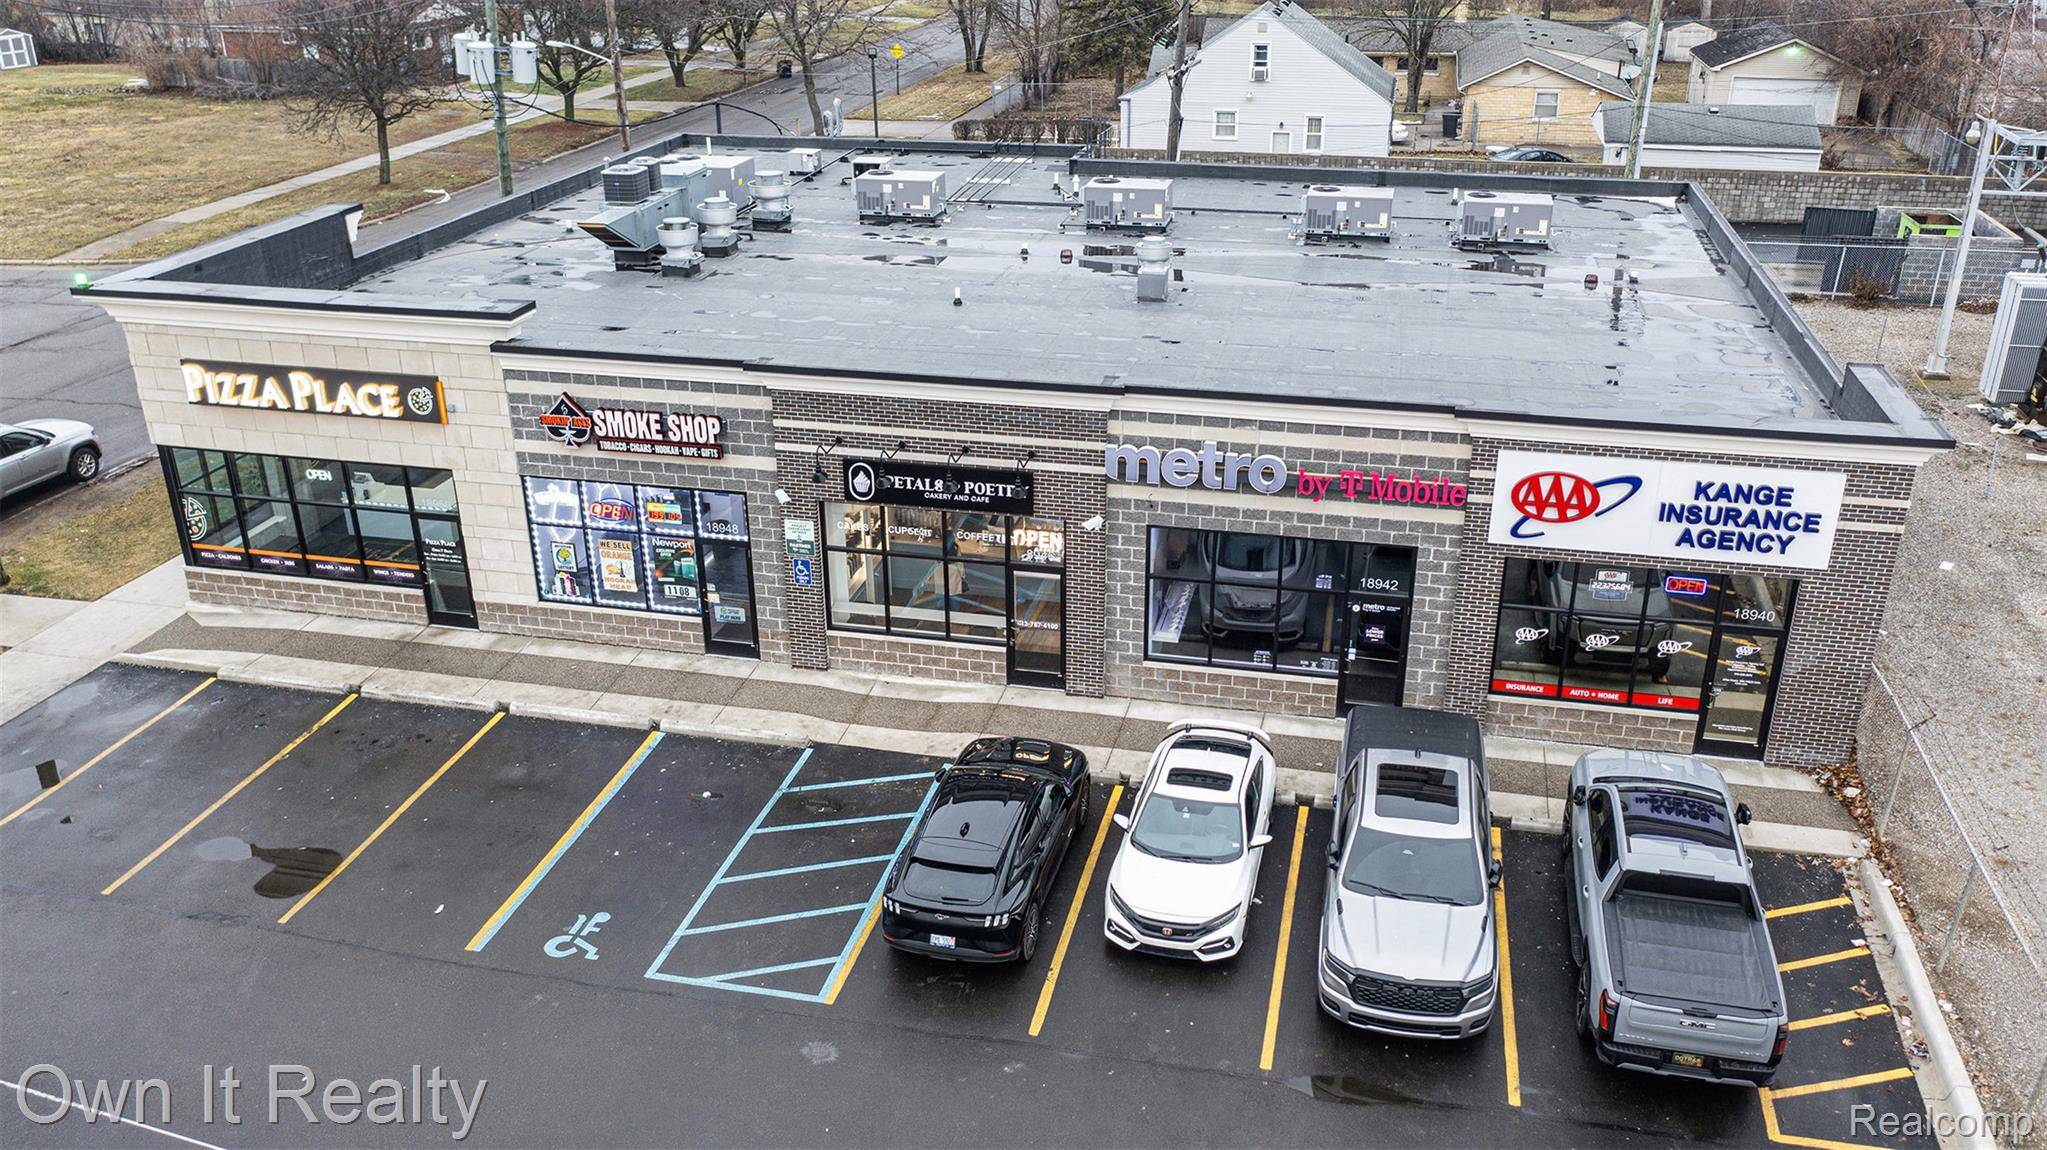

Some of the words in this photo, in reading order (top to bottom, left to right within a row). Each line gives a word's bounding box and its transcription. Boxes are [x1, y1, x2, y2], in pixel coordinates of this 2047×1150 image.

[181, 363, 290, 409] PIZZA
[288, 371, 404, 418] PLACE
[592, 409, 664, 440] SMOKE
[666, 414, 721, 444] SHOP
[599, 440, 628, 451] TOBACCO
[629, 443, 653, 453] CIGARS
[654, 445, 680, 456] HOOKAH
[681, 447, 698, 457] VAPE
[701, 449, 719, 459] GIFTS
[305, 468, 333, 481] OPEN
[1105, 441, 1288, 494] metro
[1298, 468, 1332, 502] by
[1367, 473, 1468, 507] Mobile
[924, 492, 951, 500] CAKERY
[1517, 475, 1595, 520] AAA
[1694, 481, 1795, 508] KANGE
[590, 501, 634, 521] OPEN
[1659, 503, 1823, 533] INSURANCE
[706, 522, 739, 534] 18948
[652, 538, 692, 549] Newport
[1013, 528, 1063, 551] OPEN
[1675, 528, 1797, 555] AGENCY
[601, 551, 633, 560] ORANGE
[1360, 578, 1399, 591] 18942
[1668, 578, 1705, 593] OPEN
[666, 586, 690, 597] 1108
[1734, 608, 1776, 622] 18940
[1516, 628, 1537, 641] AAA
[1586, 635, 1609, 648] AAA
[1659, 640, 1682, 654] AAA
[1505, 683, 1544, 693] INSURANCE
[1570, 689, 1590, 697] AUTO
[1597, 692, 1619, 700] HOME
[1657, 697, 1673, 705] LIFE
[1680, 1019, 1716, 1030] GMC
